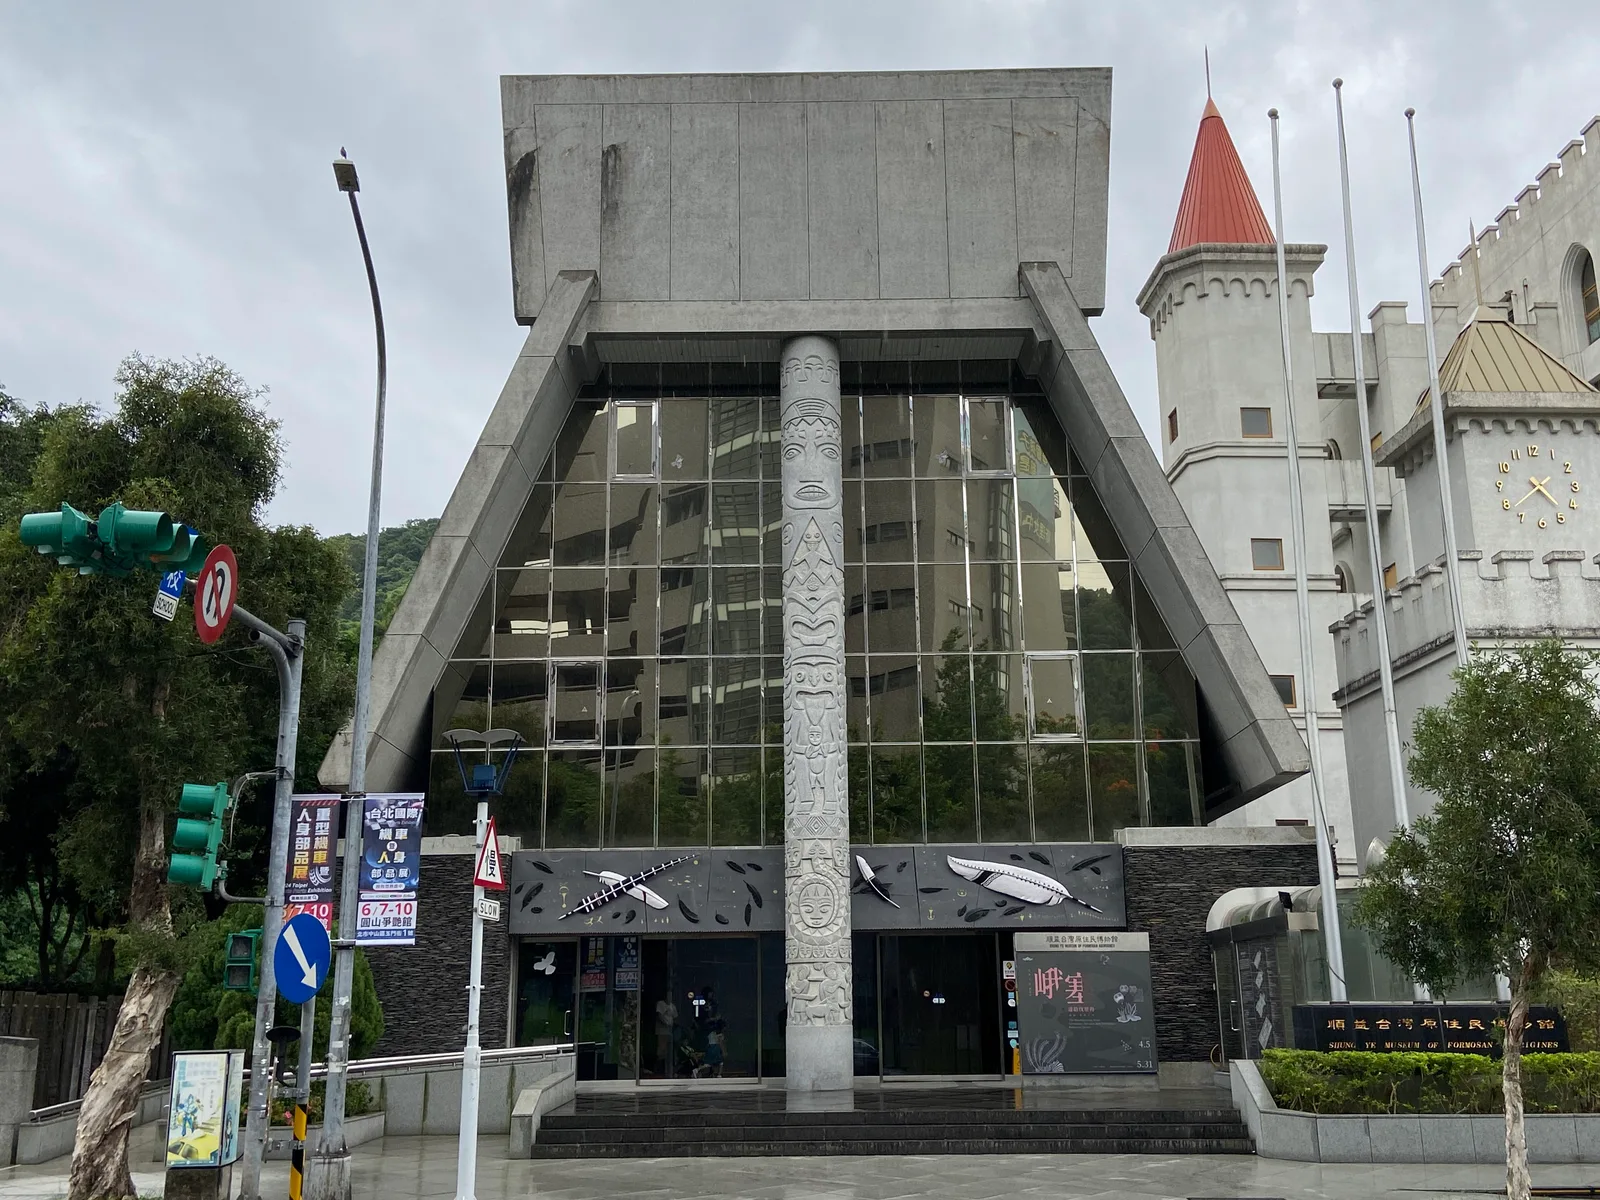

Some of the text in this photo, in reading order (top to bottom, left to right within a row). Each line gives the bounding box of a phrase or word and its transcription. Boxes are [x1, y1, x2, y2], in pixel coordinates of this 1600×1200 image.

[1511, 449, 1520, 460] 11
[1527, 444, 1539, 457] 12
[1550, 448, 1555, 460] 1
[1498, 461, 1510, 473] 10
[1563, 461, 1572, 473] 2
[1496, 480, 1503, 492] 9
[1571, 481, 1579, 492] 3
[1502, 499, 1510, 510] 8
[1569, 498, 1578, 509] 4
[1517, 512, 1525, 523] 7
[1538, 517, 1547, 528] 6
[1556, 512, 1565, 524] 5
[166, 570, 184, 592] 校
[370, 807, 419, 819] 台北國際
[312, 807, 331, 863] 重型機車
[379, 828, 408, 840] 機車
[292, 807, 312, 879] 人身部品展
[377, 851, 407, 864] 人身
[484, 849, 497, 877] 慢
[371, 868, 409, 878] 部品展
[361, 902, 413, 916] 6/7-10
[479, 902, 498, 917] SLOW
[1139, 1040, 1151, 1048] 4.5
[1328, 1041, 1356, 1049] SHUNG
[1137, 1060, 1153, 1069] 5.31
